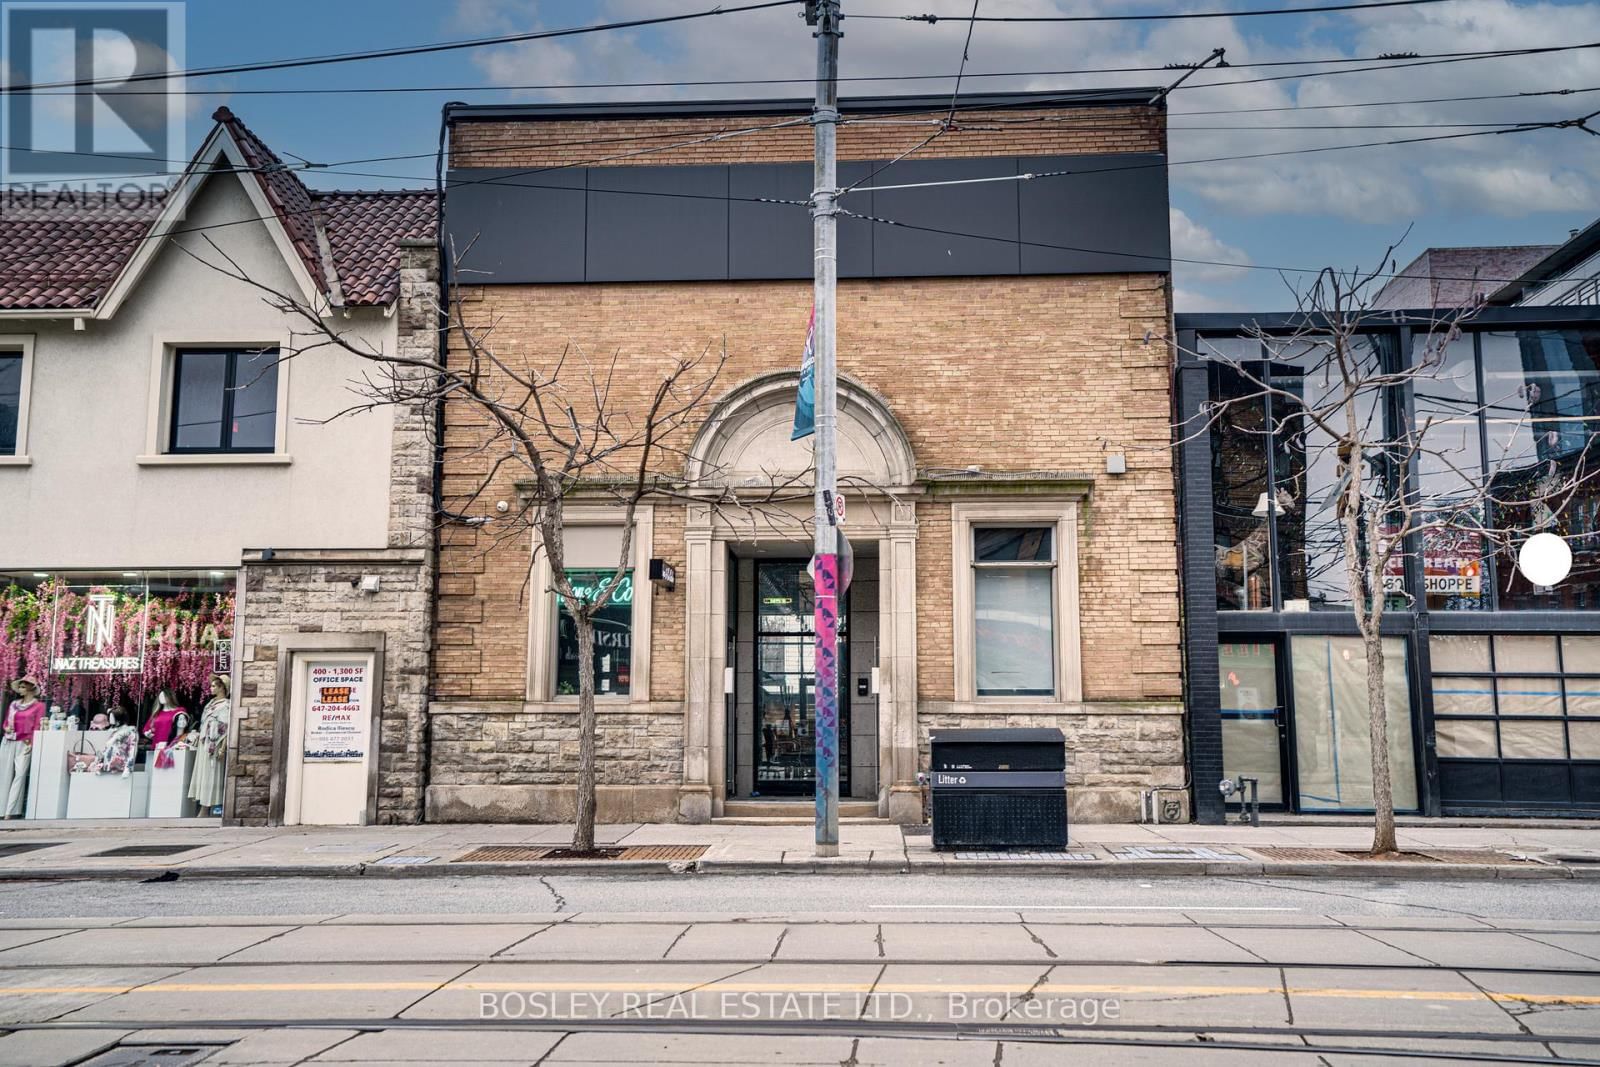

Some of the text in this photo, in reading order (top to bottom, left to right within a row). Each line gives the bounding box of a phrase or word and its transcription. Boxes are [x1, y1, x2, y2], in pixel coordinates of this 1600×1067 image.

[1424, 557, 1472, 568] REAM
[219, 641, 228, 670] OPEN
[54, 656, 140, 670] NAZ TREASURES
[333, 667, 353, 676] 1,300
[354, 667, 364, 675] SF
[323, 687, 350, 695] LEASE
[938, 774, 958, 784] Litter
